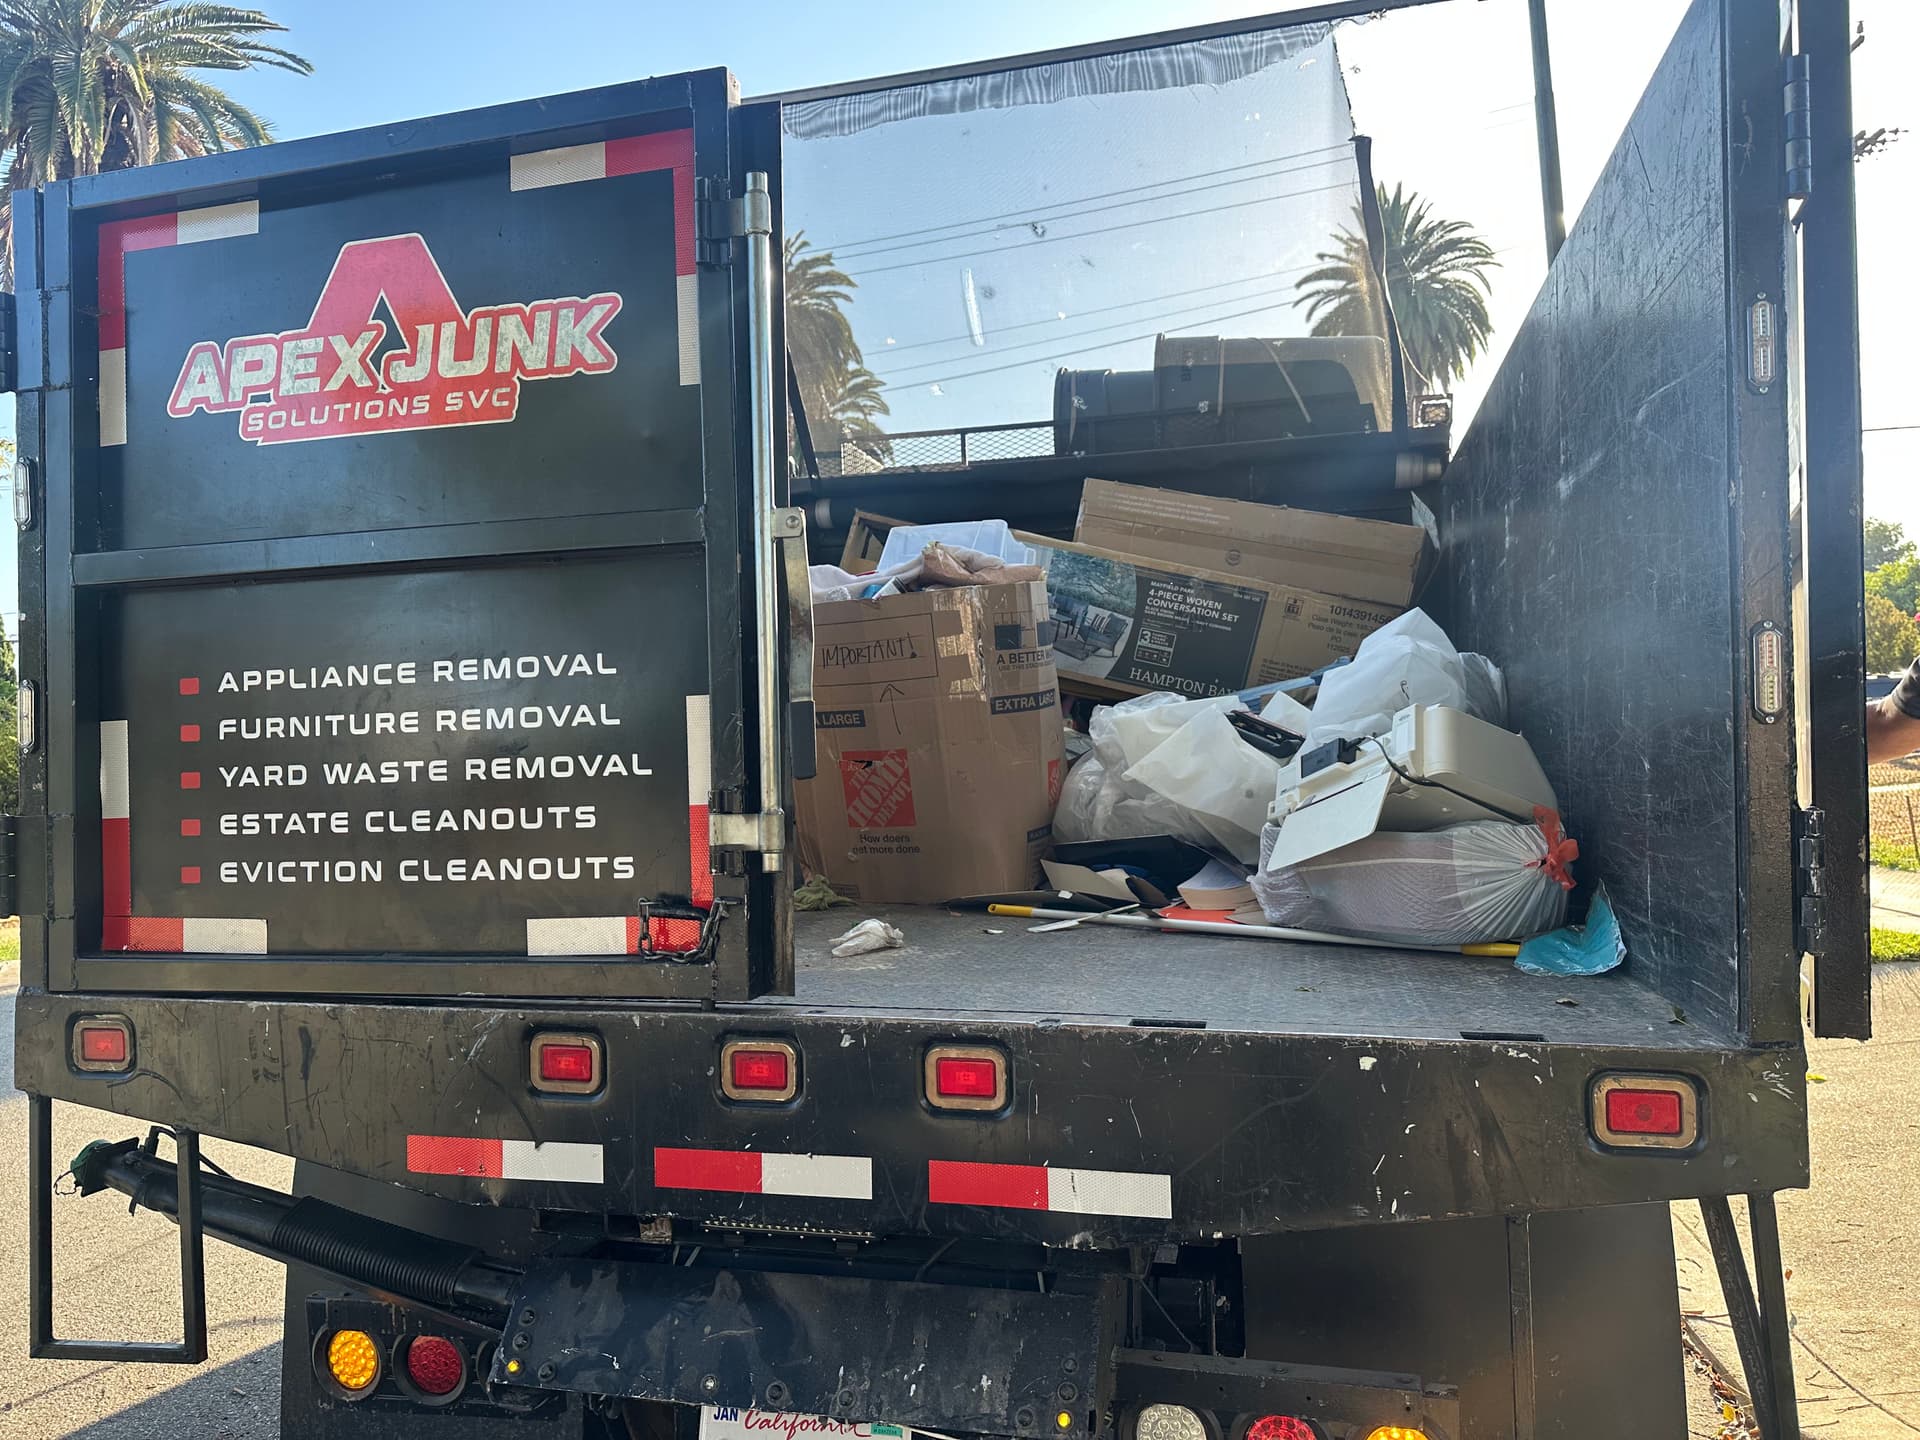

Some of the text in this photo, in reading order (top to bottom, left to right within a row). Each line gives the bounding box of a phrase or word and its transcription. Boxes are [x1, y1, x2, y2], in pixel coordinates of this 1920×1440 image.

[176, 304, 613, 408] APEX JUNK
[247, 386, 512, 433] SOLUTIONS SVC
[1149, 588, 1184, 602] 4-PIECE
[1186, 595, 1222, 610] WOVEN
[1150, 580, 1179, 592] MAYFIELD
[1146, 597, 1220, 619] CONVERSATION
[1222, 612, 1240, 623] SET
[822, 632, 917, 669] IMPORTANT!
[1141, 630, 1151, 644] 3
[996, 652, 1006, 666] A
[1008, 649, 1045, 666] BETTER
[218, 652, 617, 694] APPLIANCE REMOVAL
[1129, 667, 1205, 695] HAMPTON
[995, 696, 1034, 712] EXTRA
[218, 703, 621, 741] FURNITURE REMOVAL
[822, 713, 861, 726] LARGE
[218, 753, 653, 788] YARD WASTE REMOVAL
[847, 751, 908, 827] HOME
[873, 777, 912, 827] DEPOT
[219, 805, 597, 836] ESTATE CLEANOUTS
[852, 844, 921, 856] get more done
[859, 834, 911, 843] How doers
[219, 856, 635, 884] EVICTION CLEANOUTS
[713, 1407, 739, 1422] JAN
[744, 1410, 872, 1440] California
